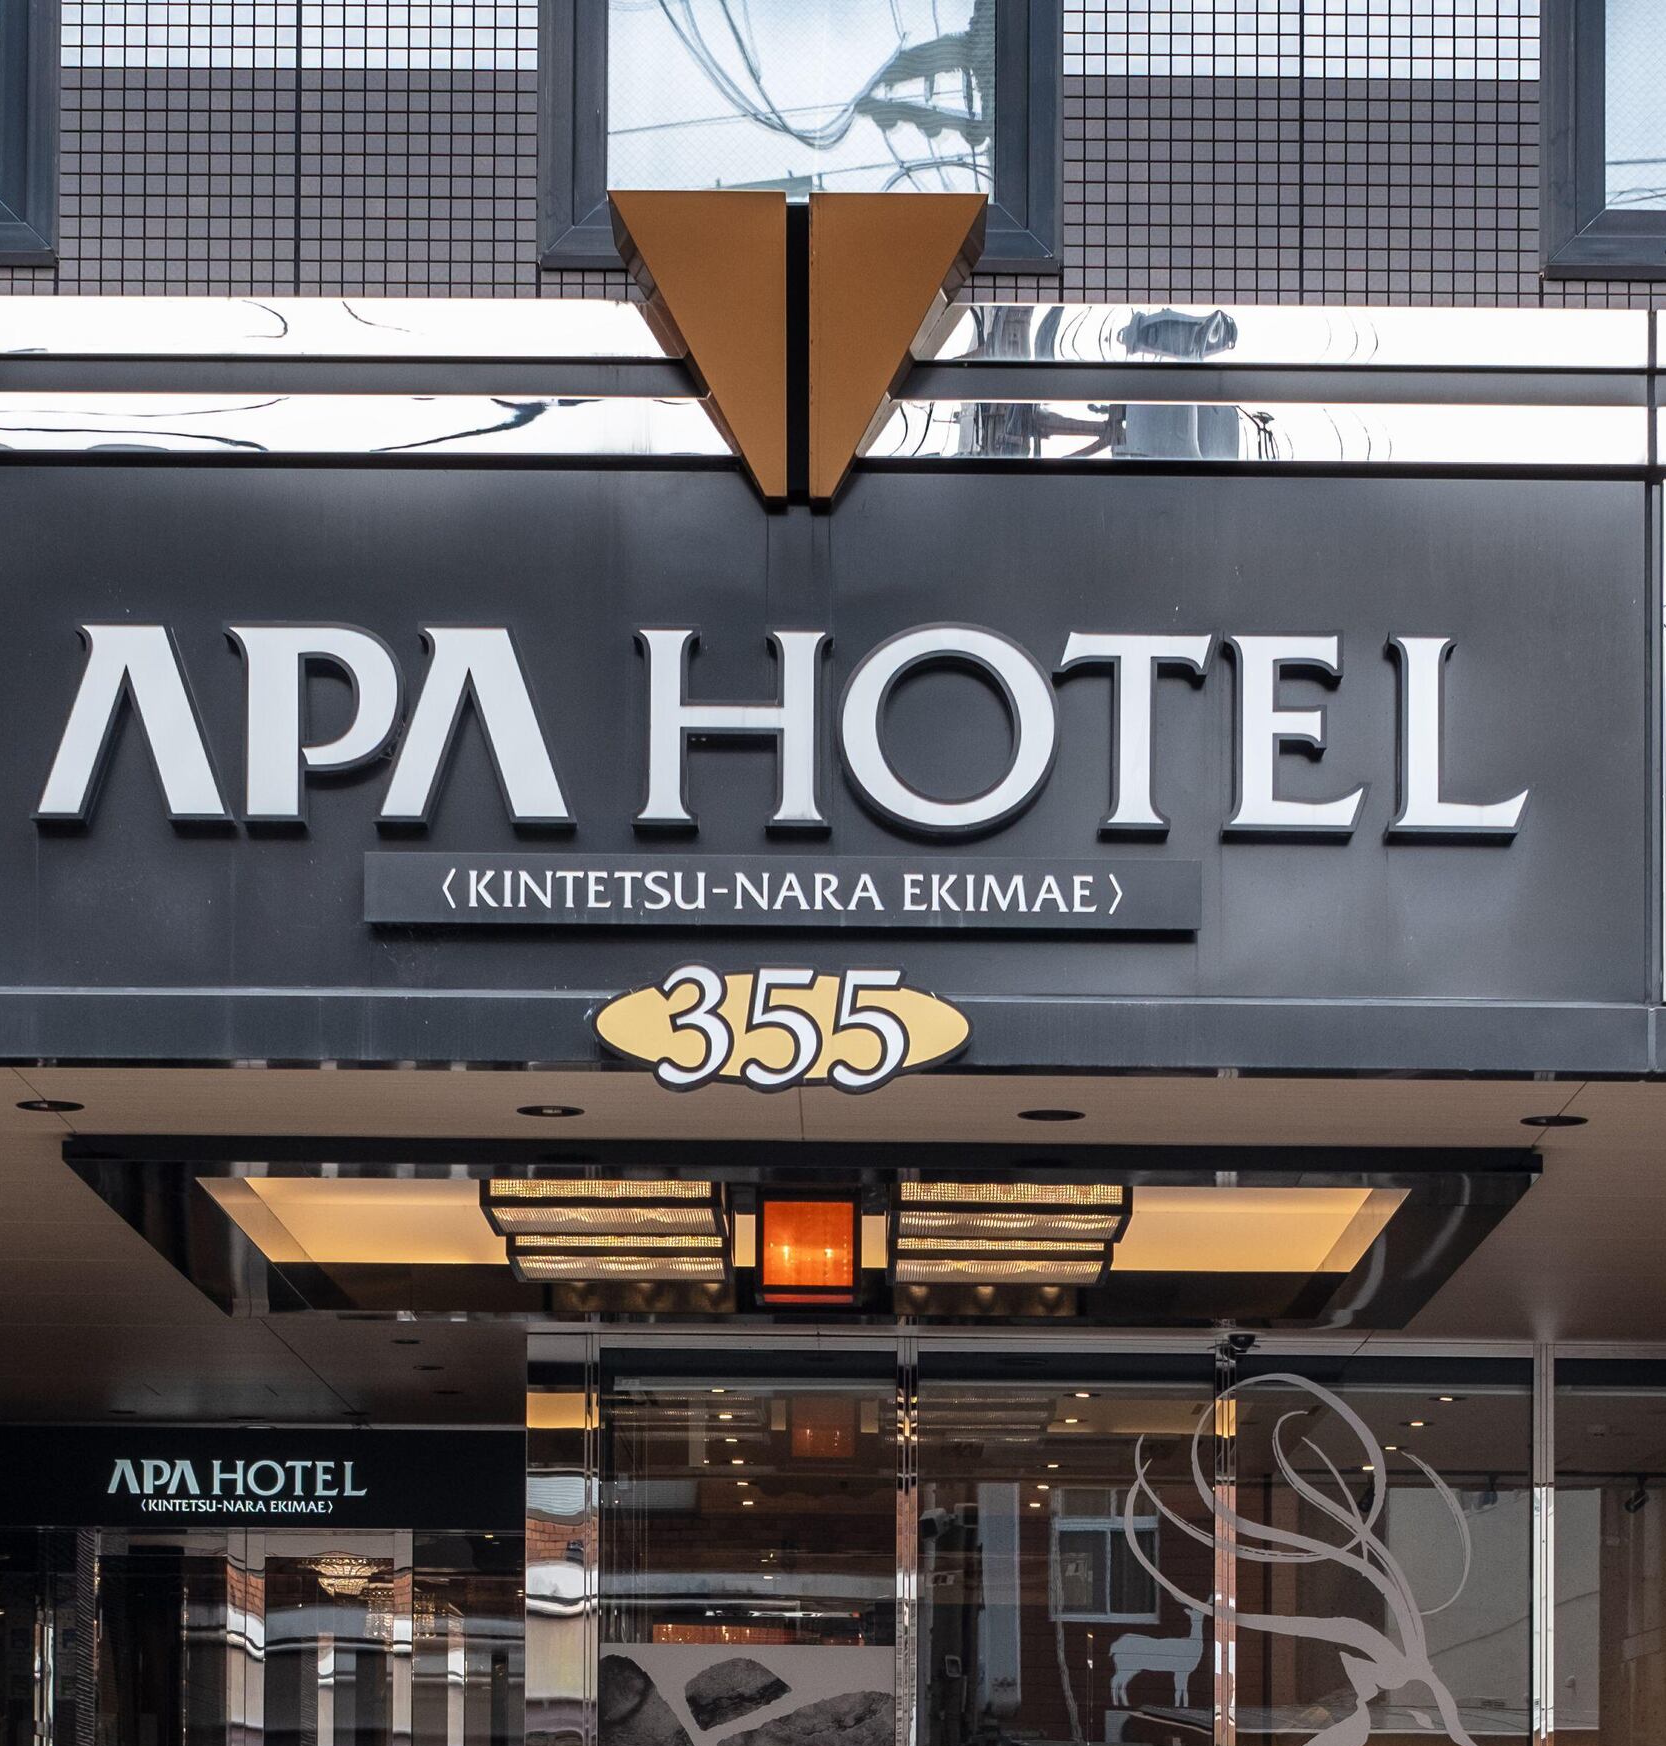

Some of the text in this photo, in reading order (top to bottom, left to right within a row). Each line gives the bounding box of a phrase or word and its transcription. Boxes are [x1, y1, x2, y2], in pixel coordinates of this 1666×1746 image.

[36, 622, 1530, 830] APA HOTEL
[657, 964, 908, 1088] 355
[107, 1459, 368, 1497] APA HOTEL
